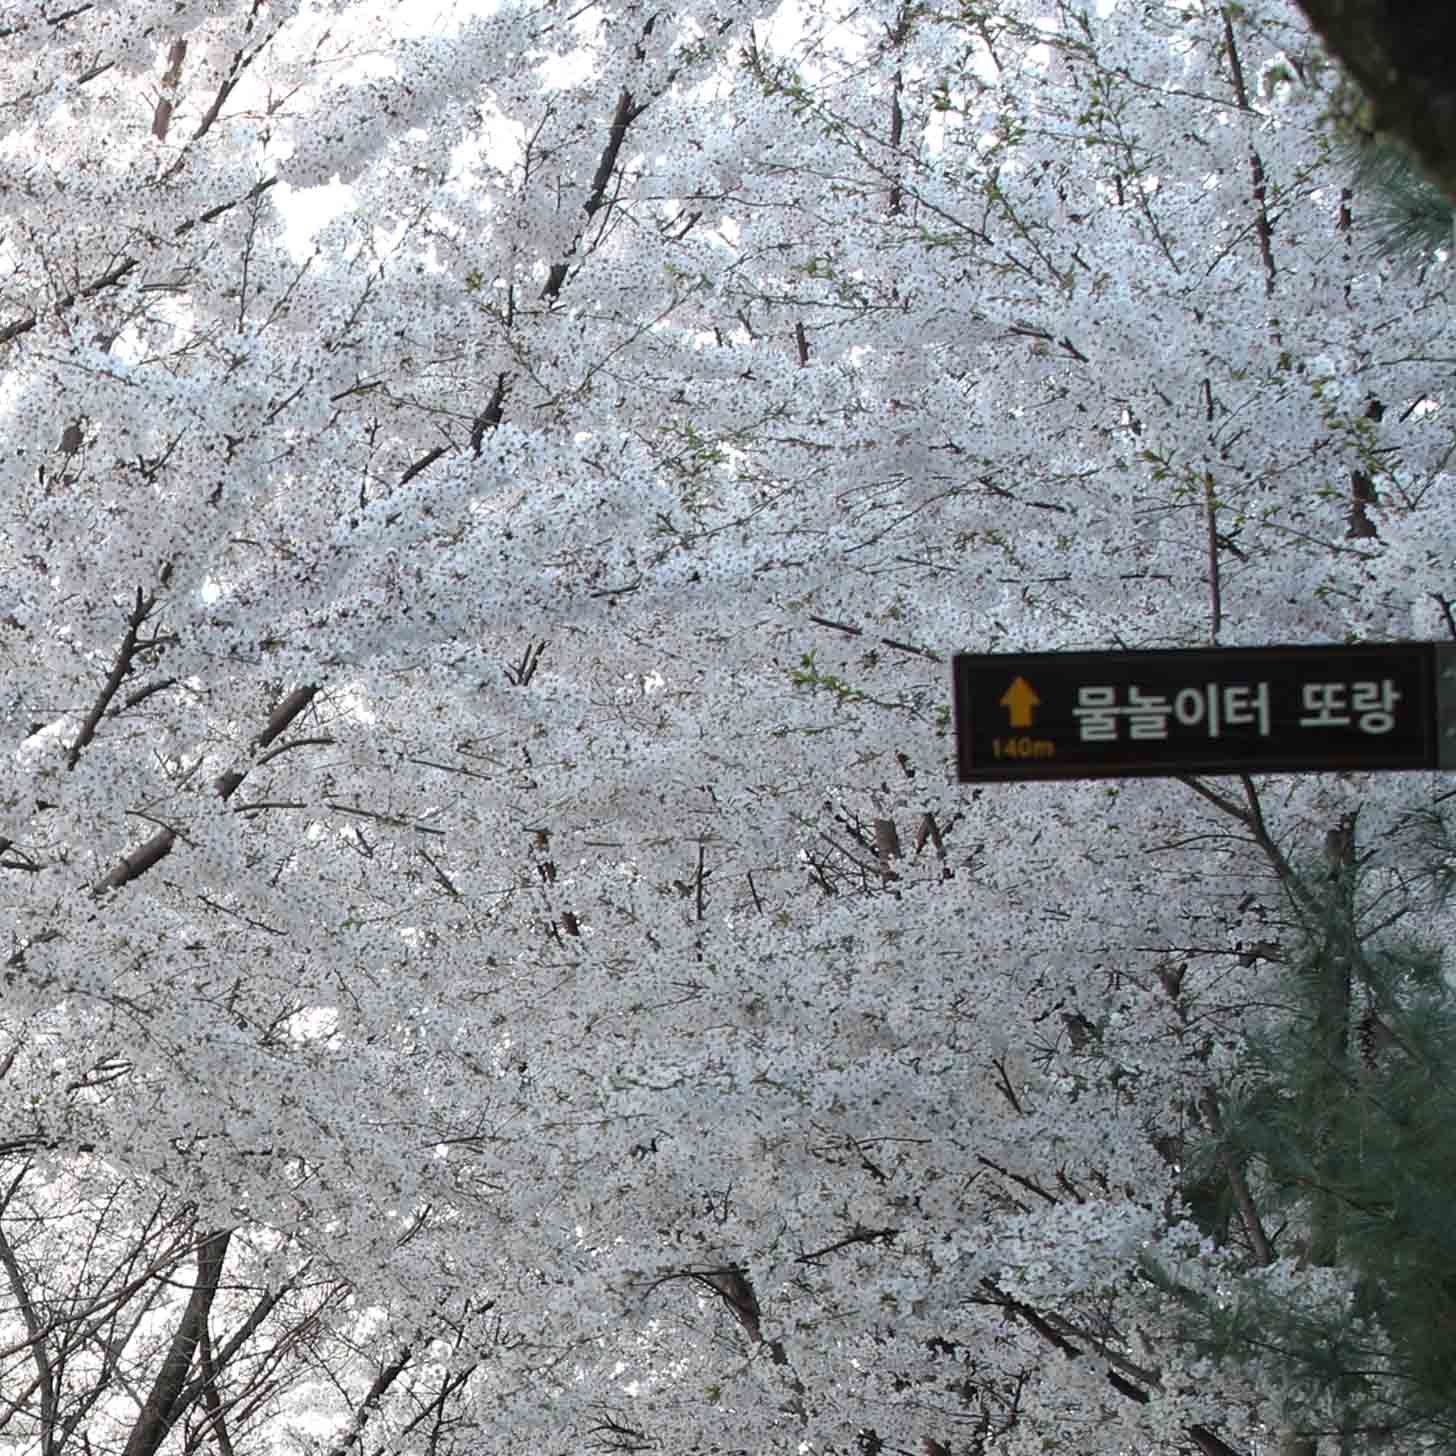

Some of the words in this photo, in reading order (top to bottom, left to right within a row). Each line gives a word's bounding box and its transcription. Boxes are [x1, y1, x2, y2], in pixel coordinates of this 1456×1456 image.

[1072, 682, 1270, 741] 물놀이터
[1299, 679, 1401, 734] 또랑
[992, 736, 1055, 758] 140m
